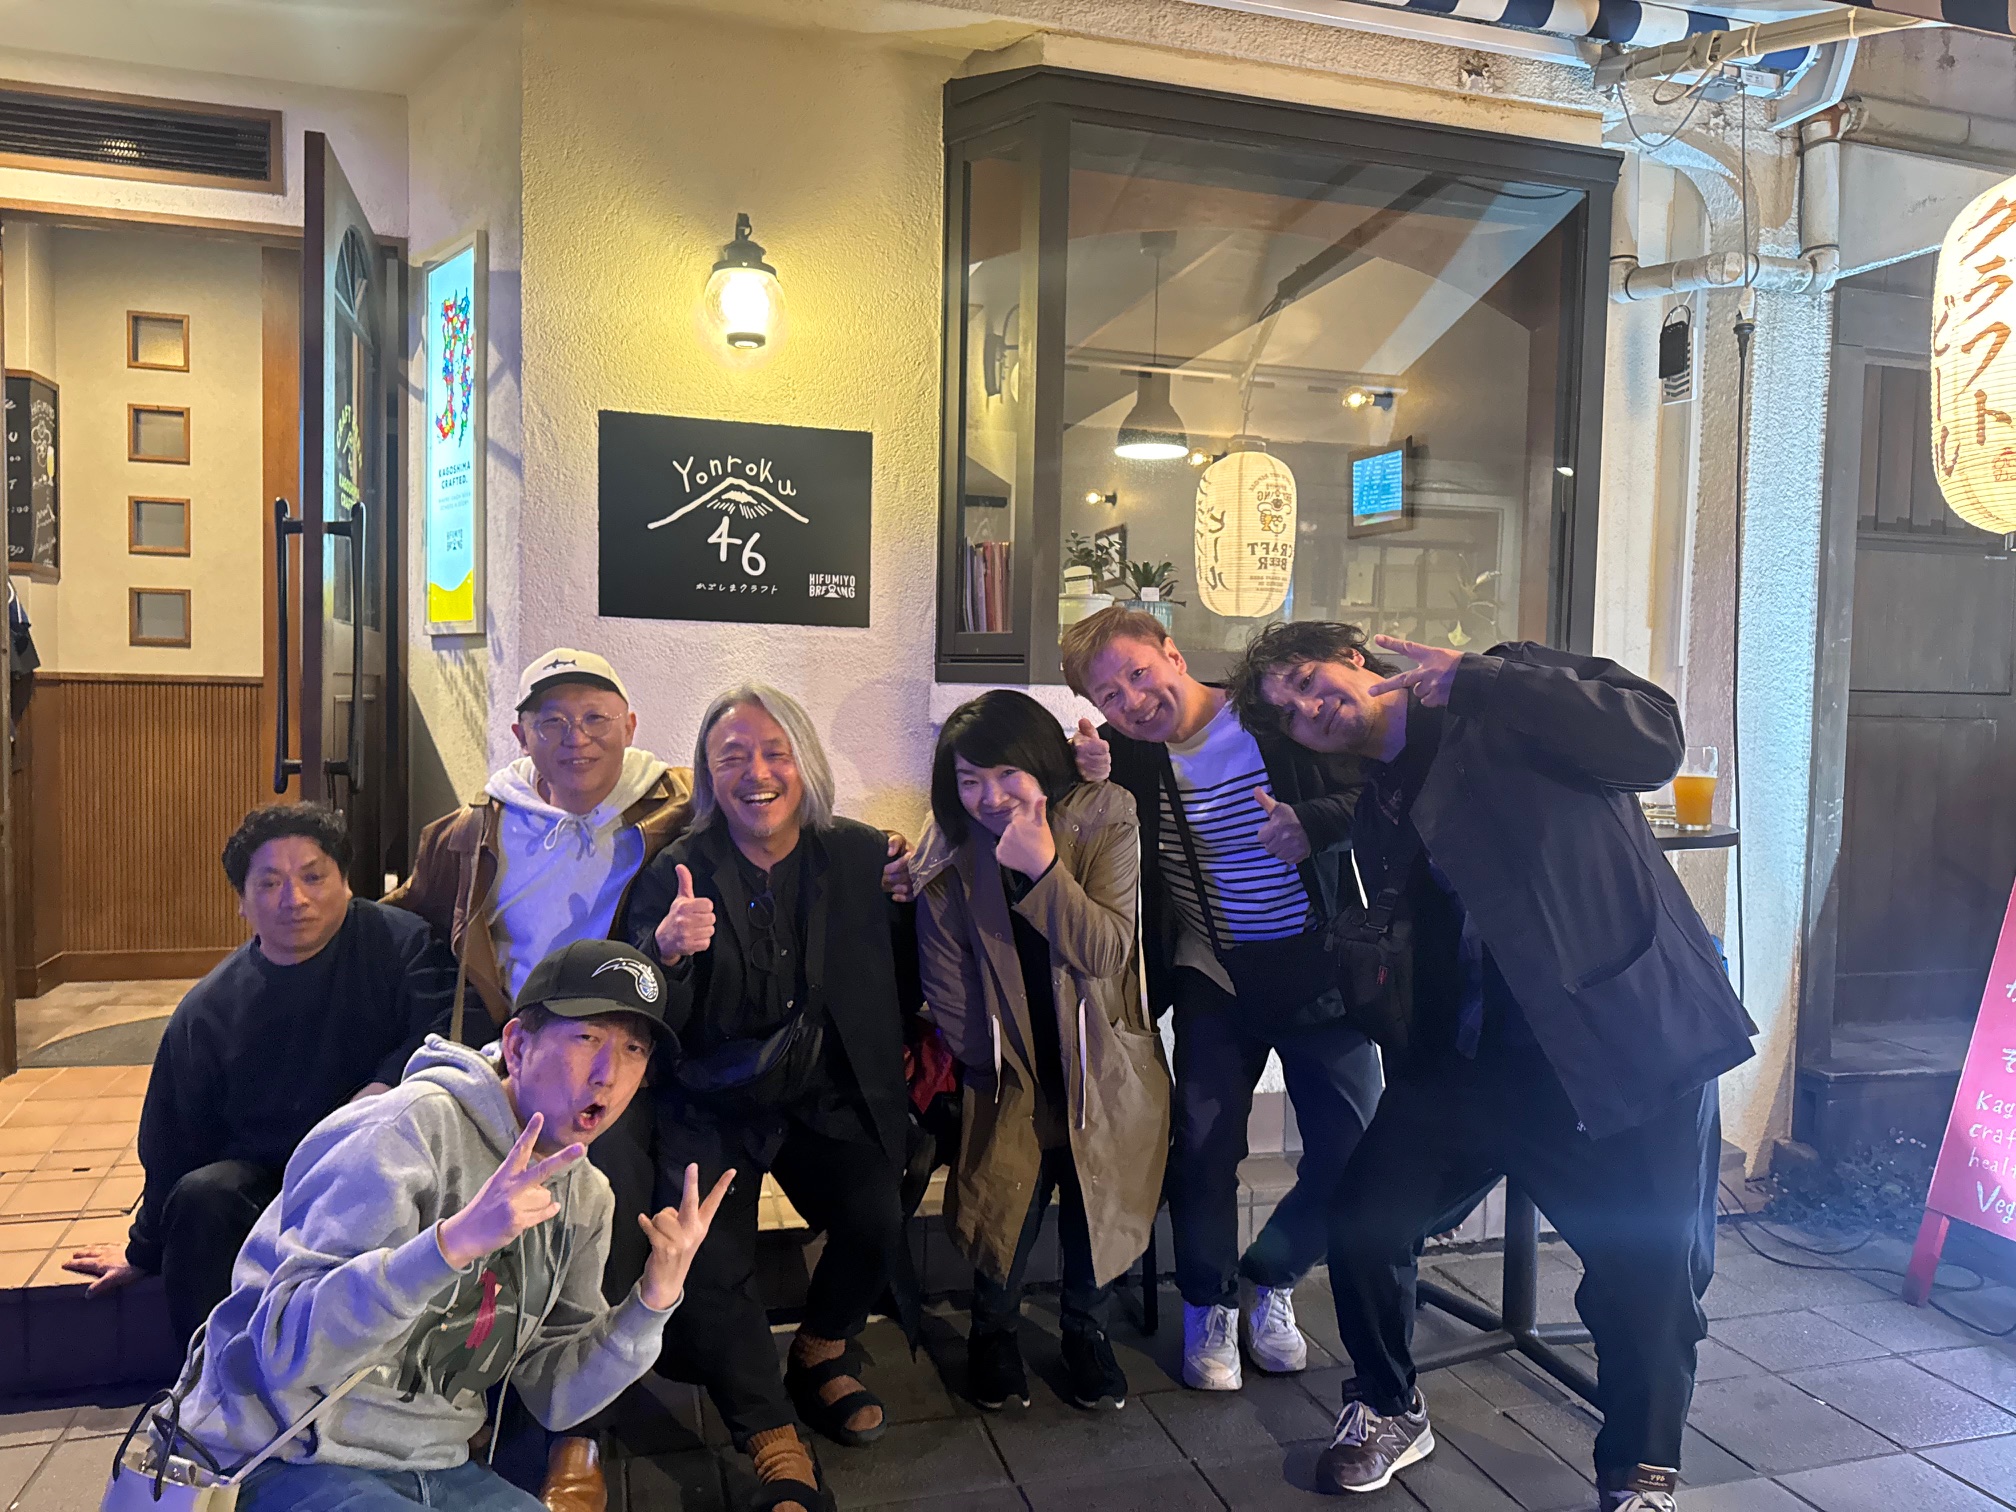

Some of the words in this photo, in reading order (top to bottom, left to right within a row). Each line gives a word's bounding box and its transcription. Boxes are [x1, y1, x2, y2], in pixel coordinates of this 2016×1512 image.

[672, 455, 797, 496] Yonroku
[707, 515, 767, 576] 46
[809, 573, 856, 587] HIFUMIYO
